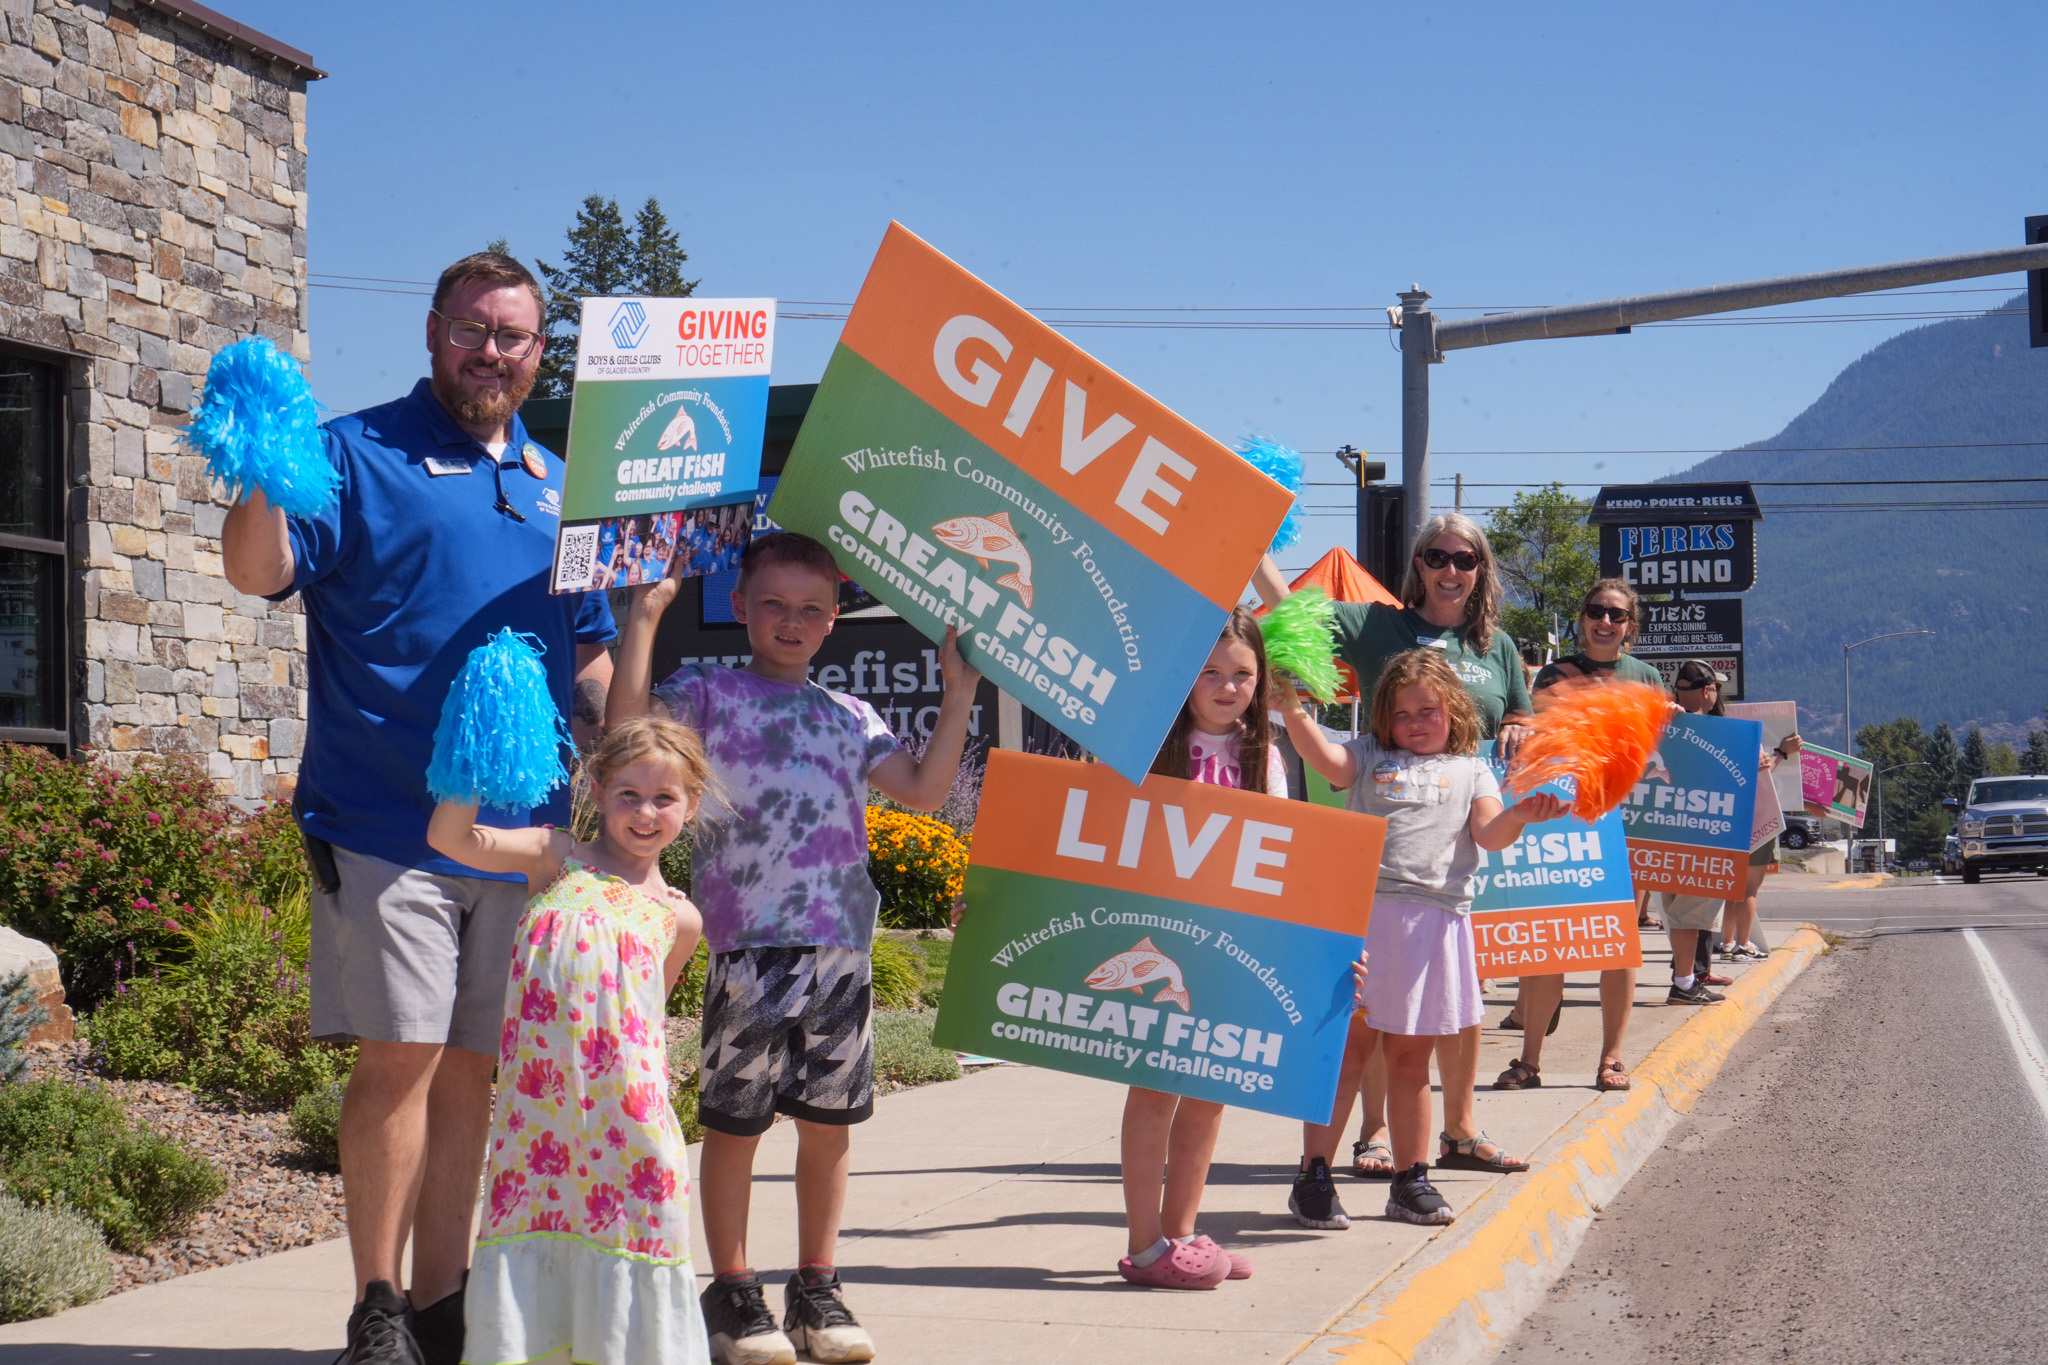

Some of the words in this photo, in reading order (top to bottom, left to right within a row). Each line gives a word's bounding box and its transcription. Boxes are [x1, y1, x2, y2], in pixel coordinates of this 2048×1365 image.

[678, 310, 767, 340] GIVING
[588, 355, 608, 365] BOYS
[609, 356, 615, 365] &
[617, 355, 638, 365] GIRLS
[639, 355, 662, 365] CLUBS
[676, 343, 765, 366] TOGETHER
[628, 366, 651, 374] COUNTRY
[614, 400, 656, 451] Whitefish
[656, 388, 703, 407] Community
[702, 391, 732, 445] Foundation
[933, 314, 1198, 536] GIVE
[617, 456, 684, 485] GREAT
[615, 484, 677, 502] community
[677, 481, 722, 497] challenge
[1605, 498, 1643, 509] KENO
[1649, 497, 1695, 508] POKER
[1703, 496, 1743, 506] REELS
[839, 490, 1000, 619] GREAT
[1618, 524, 1735, 563] FERKS
[841, 445, 948, 474] Whitefish
[954, 456, 1074, 545] Community
[1071, 540, 1143, 673] Foundation
[1622, 559, 1732, 585] CASINO
[828, 525, 974, 639] community
[974, 631, 1097, 725] challenge
[1648, 603, 1706, 622] TIEN'S
[1649, 623, 1682, 632] EXPRESS
[1683, 622, 1707, 631] DINING
[1653, 635, 1667, 644] OUT
[1671, 635, 1690, 644] (406)
[1691, 634, 1723, 643] 892-1585
[1461, 661, 1493, 679] Your
[1712, 660, 1736, 670] 2025
[1682, 727, 1748, 787] Foundation
[1800, 754, 1822, 764] row's
[1821, 763, 1832, 781] nest
[1643, 810, 1732, 835] challenge
[1055, 787, 1294, 896] LIVE
[1493, 867, 1605, 888] challenge
[1630, 869, 1672, 884] HEAD
[1677, 874, 1735, 891] VALLEY
[1474, 915, 1625, 947] TOGETHER
[991, 912, 1086, 968] Whitefish
[1091, 907, 1213, 945] Community
[1213, 930, 1303, 1026] Foundation
[1475, 948, 1548, 968] THEAD
[1553, 942, 1627, 960] VALLEY
[996, 982, 1159, 1041] GREAT
[991, 1021, 1143, 1069] community
[1145, 1049, 1274, 1093] challenge
